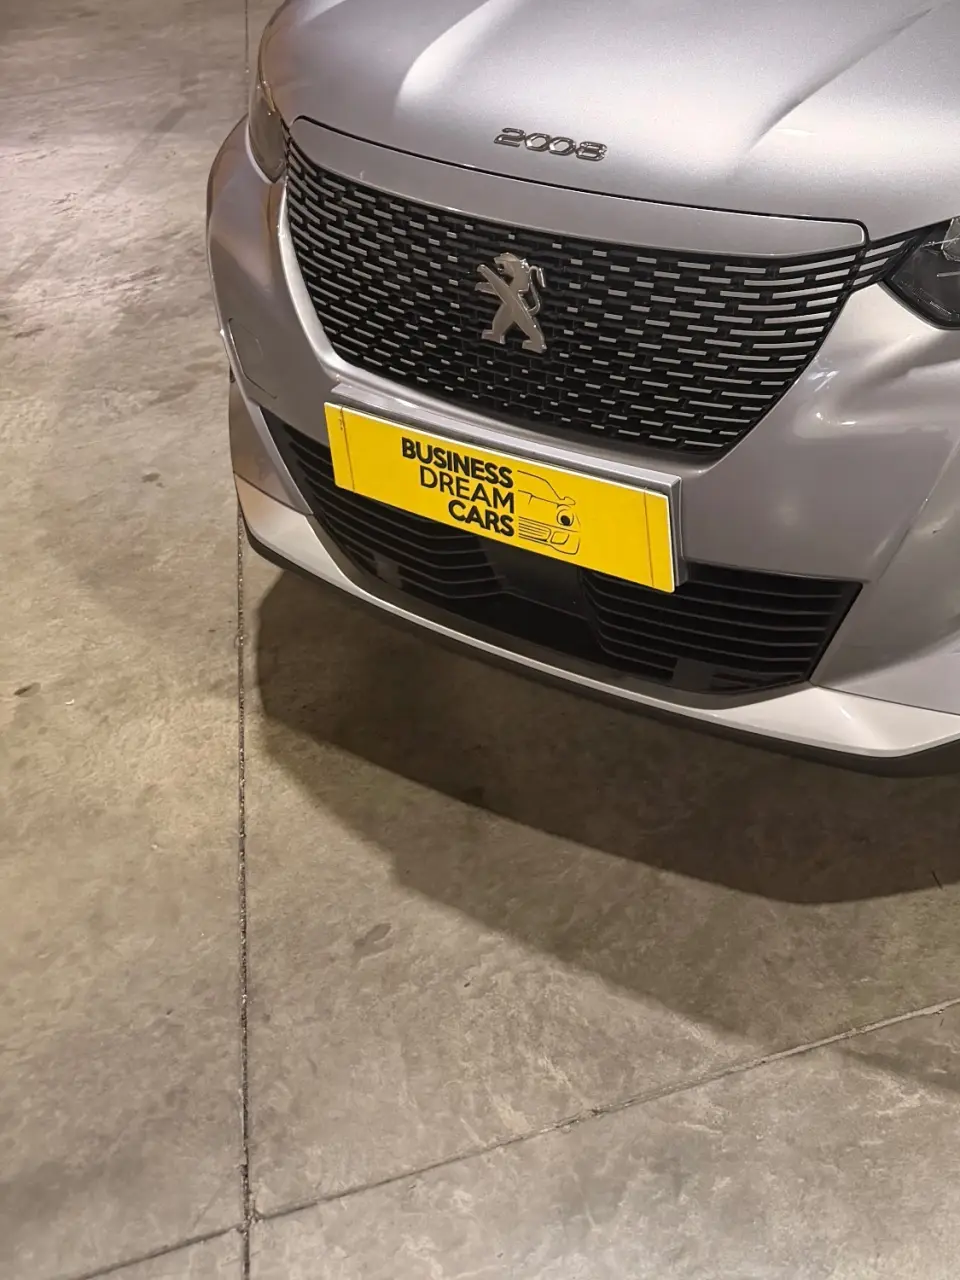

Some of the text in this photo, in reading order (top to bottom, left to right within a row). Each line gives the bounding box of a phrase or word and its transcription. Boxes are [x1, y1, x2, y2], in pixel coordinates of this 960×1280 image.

[494, 128, 608, 162] 2008
[402, 437, 513, 488] BUSINESS
[420, 465, 514, 513] DREAM
[448, 500, 514, 537] CARS
